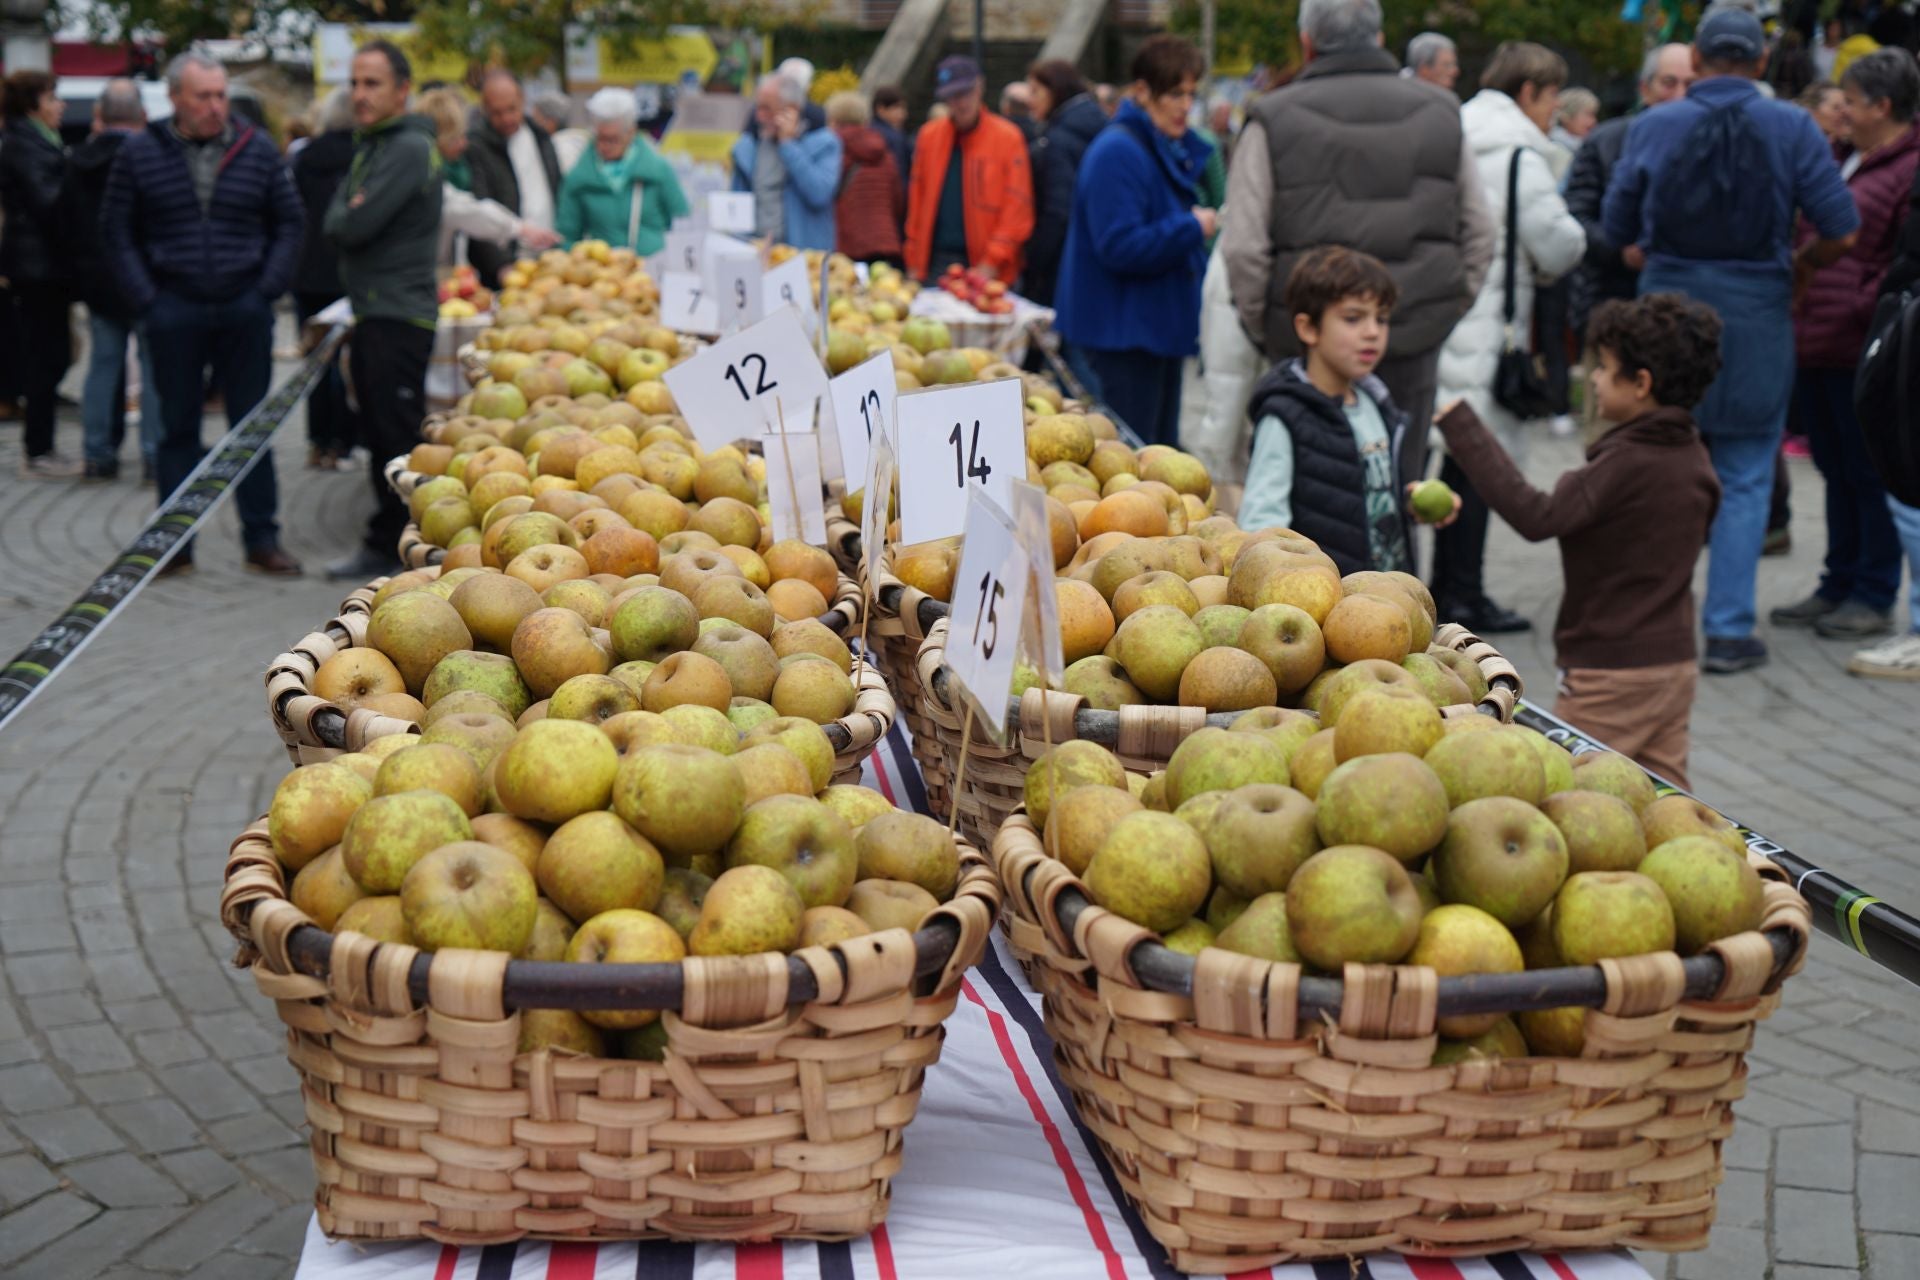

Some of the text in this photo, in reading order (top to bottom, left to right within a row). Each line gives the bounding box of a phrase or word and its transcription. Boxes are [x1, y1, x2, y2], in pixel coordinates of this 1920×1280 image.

[725, 353, 778, 401] 12
[949, 420, 991, 488] 14
[972, 571, 1005, 661] 15
